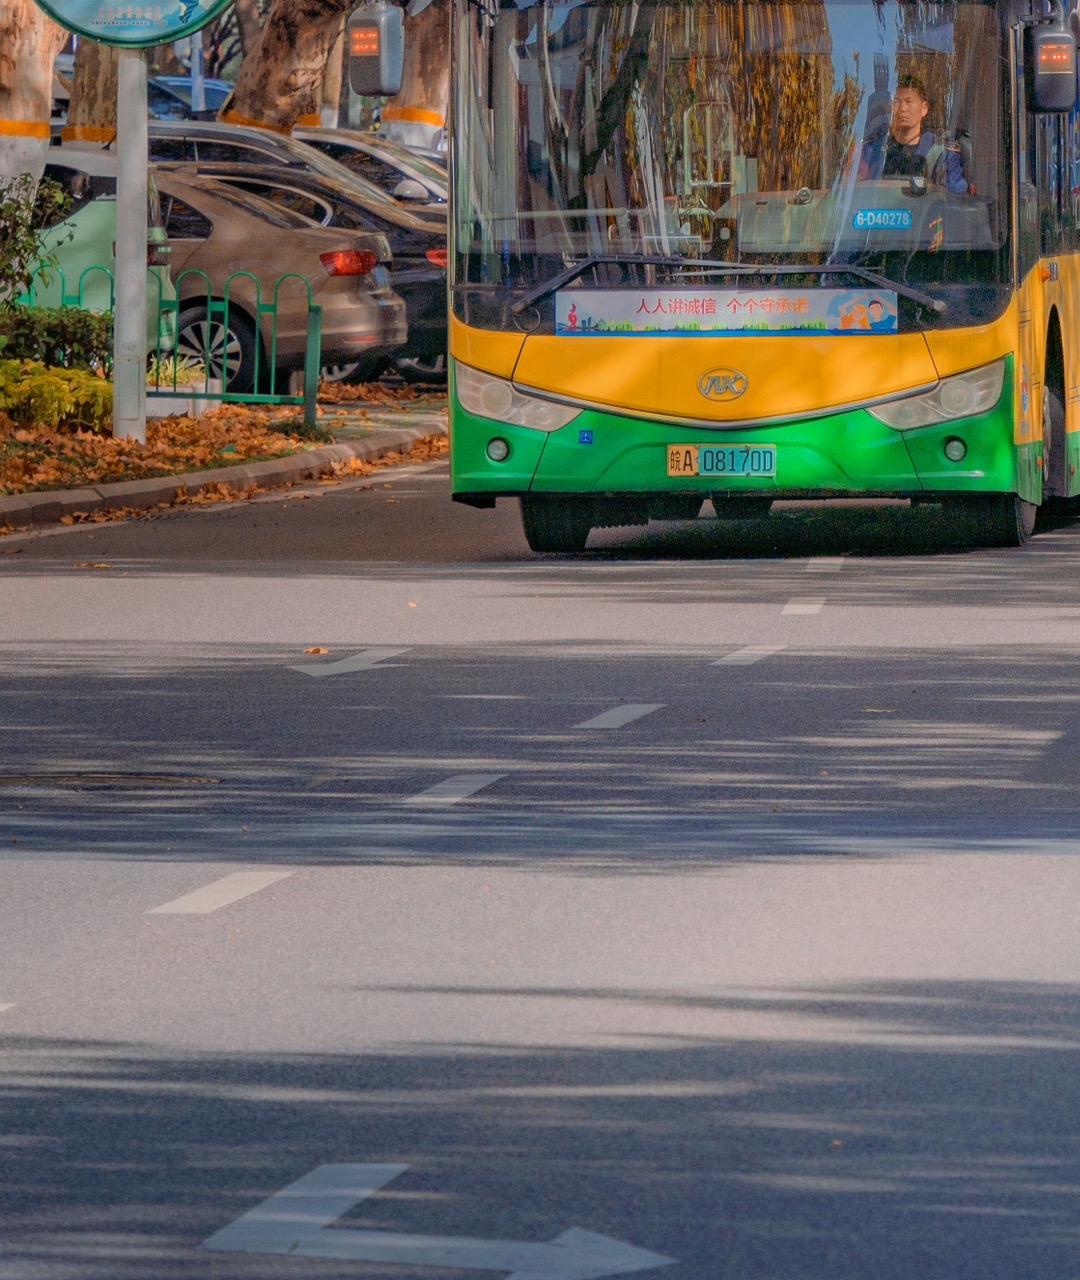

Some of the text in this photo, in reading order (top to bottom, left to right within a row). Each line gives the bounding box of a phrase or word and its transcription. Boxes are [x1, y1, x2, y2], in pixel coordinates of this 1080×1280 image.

[857, 211, 910, 226] 6-D40278
[636, 298, 809, 315] 人人讲诚信 个个守承诺
